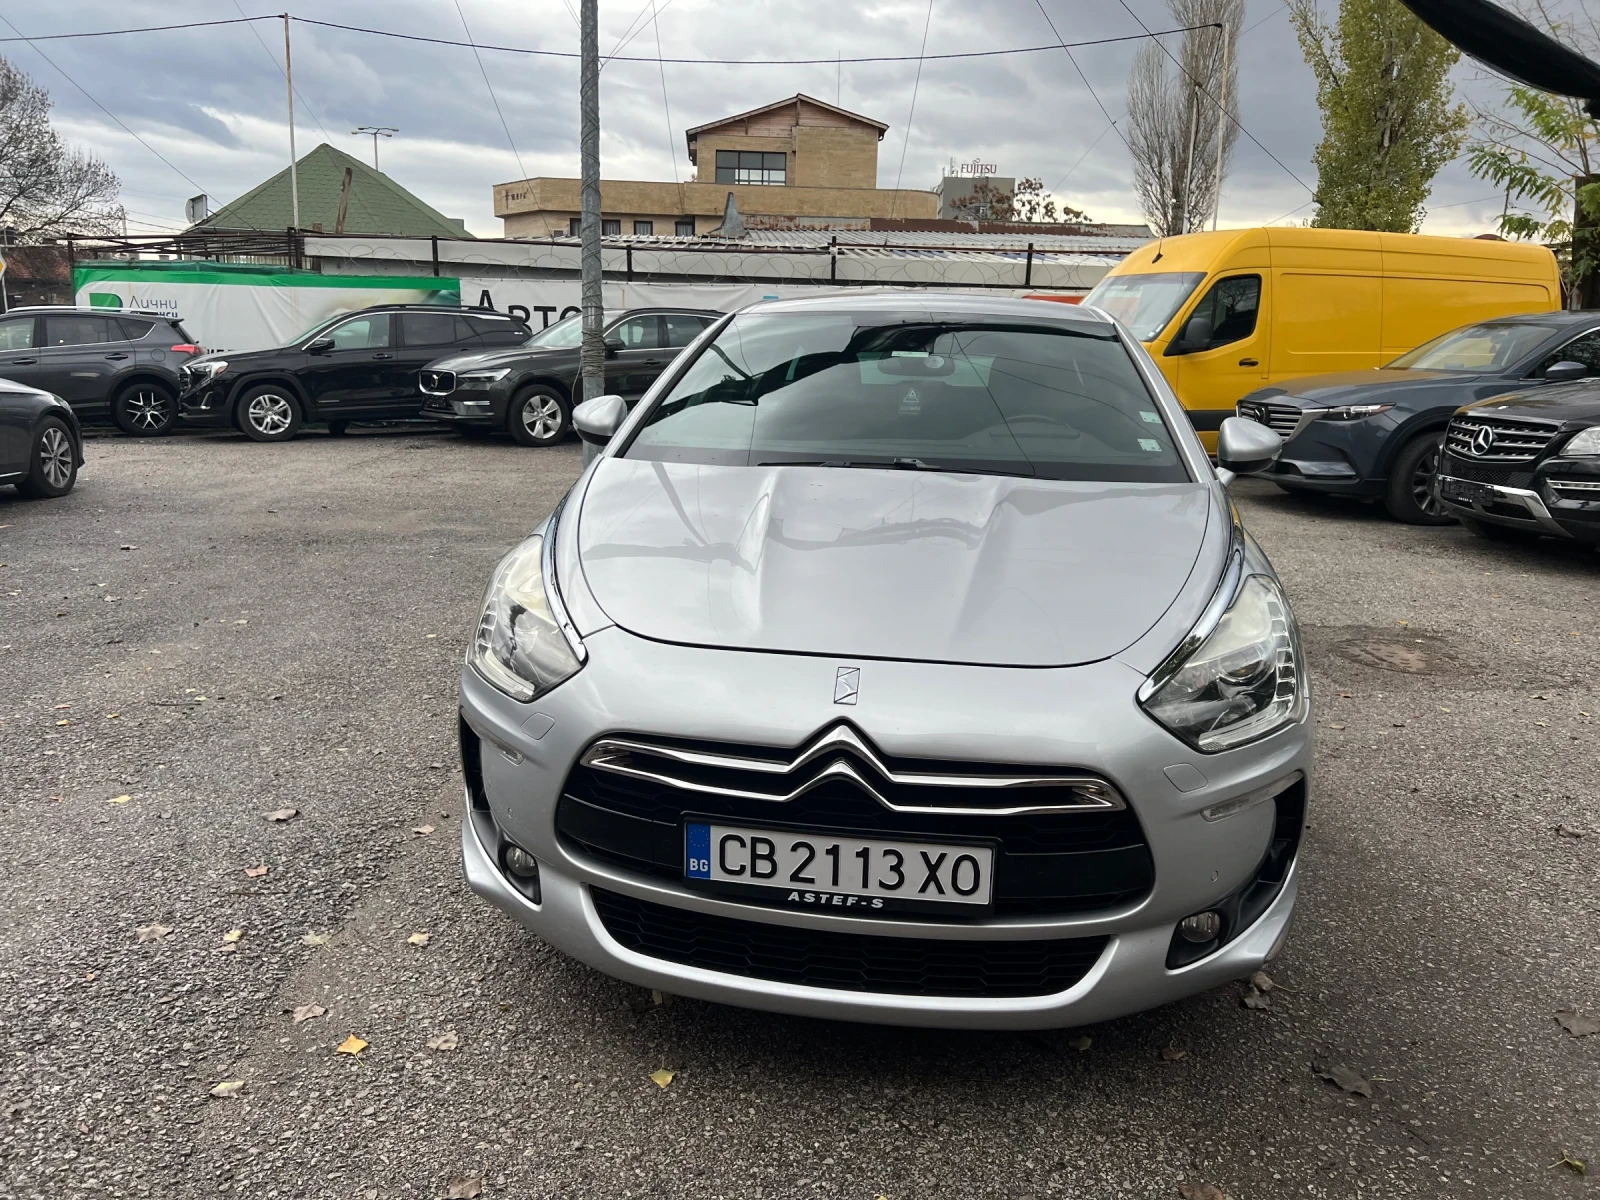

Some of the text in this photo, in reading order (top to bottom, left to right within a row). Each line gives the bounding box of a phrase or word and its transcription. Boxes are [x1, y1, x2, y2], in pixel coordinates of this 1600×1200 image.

[961, 160, 997, 175] FUJITSU
[129, 295, 178, 309] Лични
[689, 858, 709, 872] BG
[719, 833, 981, 897] CB 2113 XO
[787, 891, 884, 909] ASTEF-S
